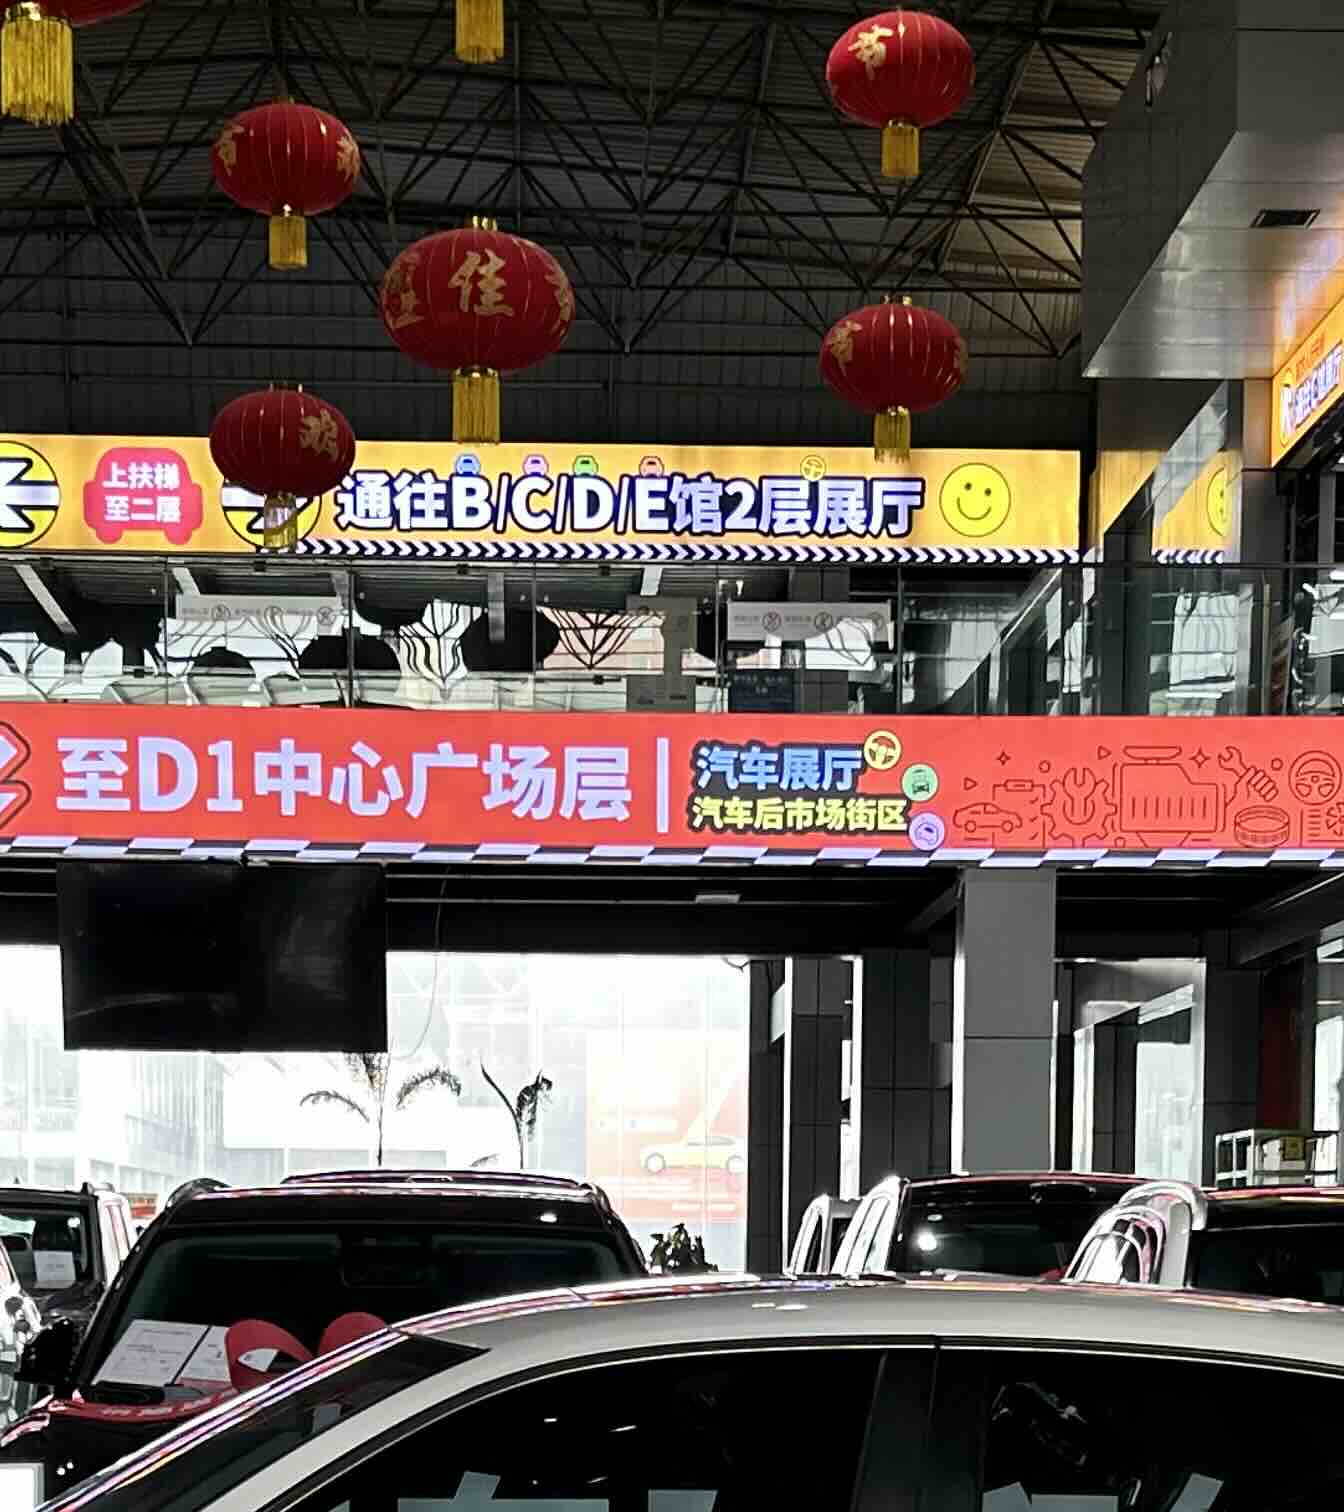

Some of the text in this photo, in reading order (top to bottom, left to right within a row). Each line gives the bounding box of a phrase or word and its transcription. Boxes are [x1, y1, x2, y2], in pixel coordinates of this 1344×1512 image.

[102, 461, 180, 491] 上扶梯
[104, 495, 182, 523] 至二层
[335, 469, 925, 541] 通往B/C/D/E馆2层展厅
[56, 735, 633, 823] 至D1中心广场层
[693, 745, 863, 792] 汽车展厅
[690, 796, 910, 833] 汽车后市场街区
